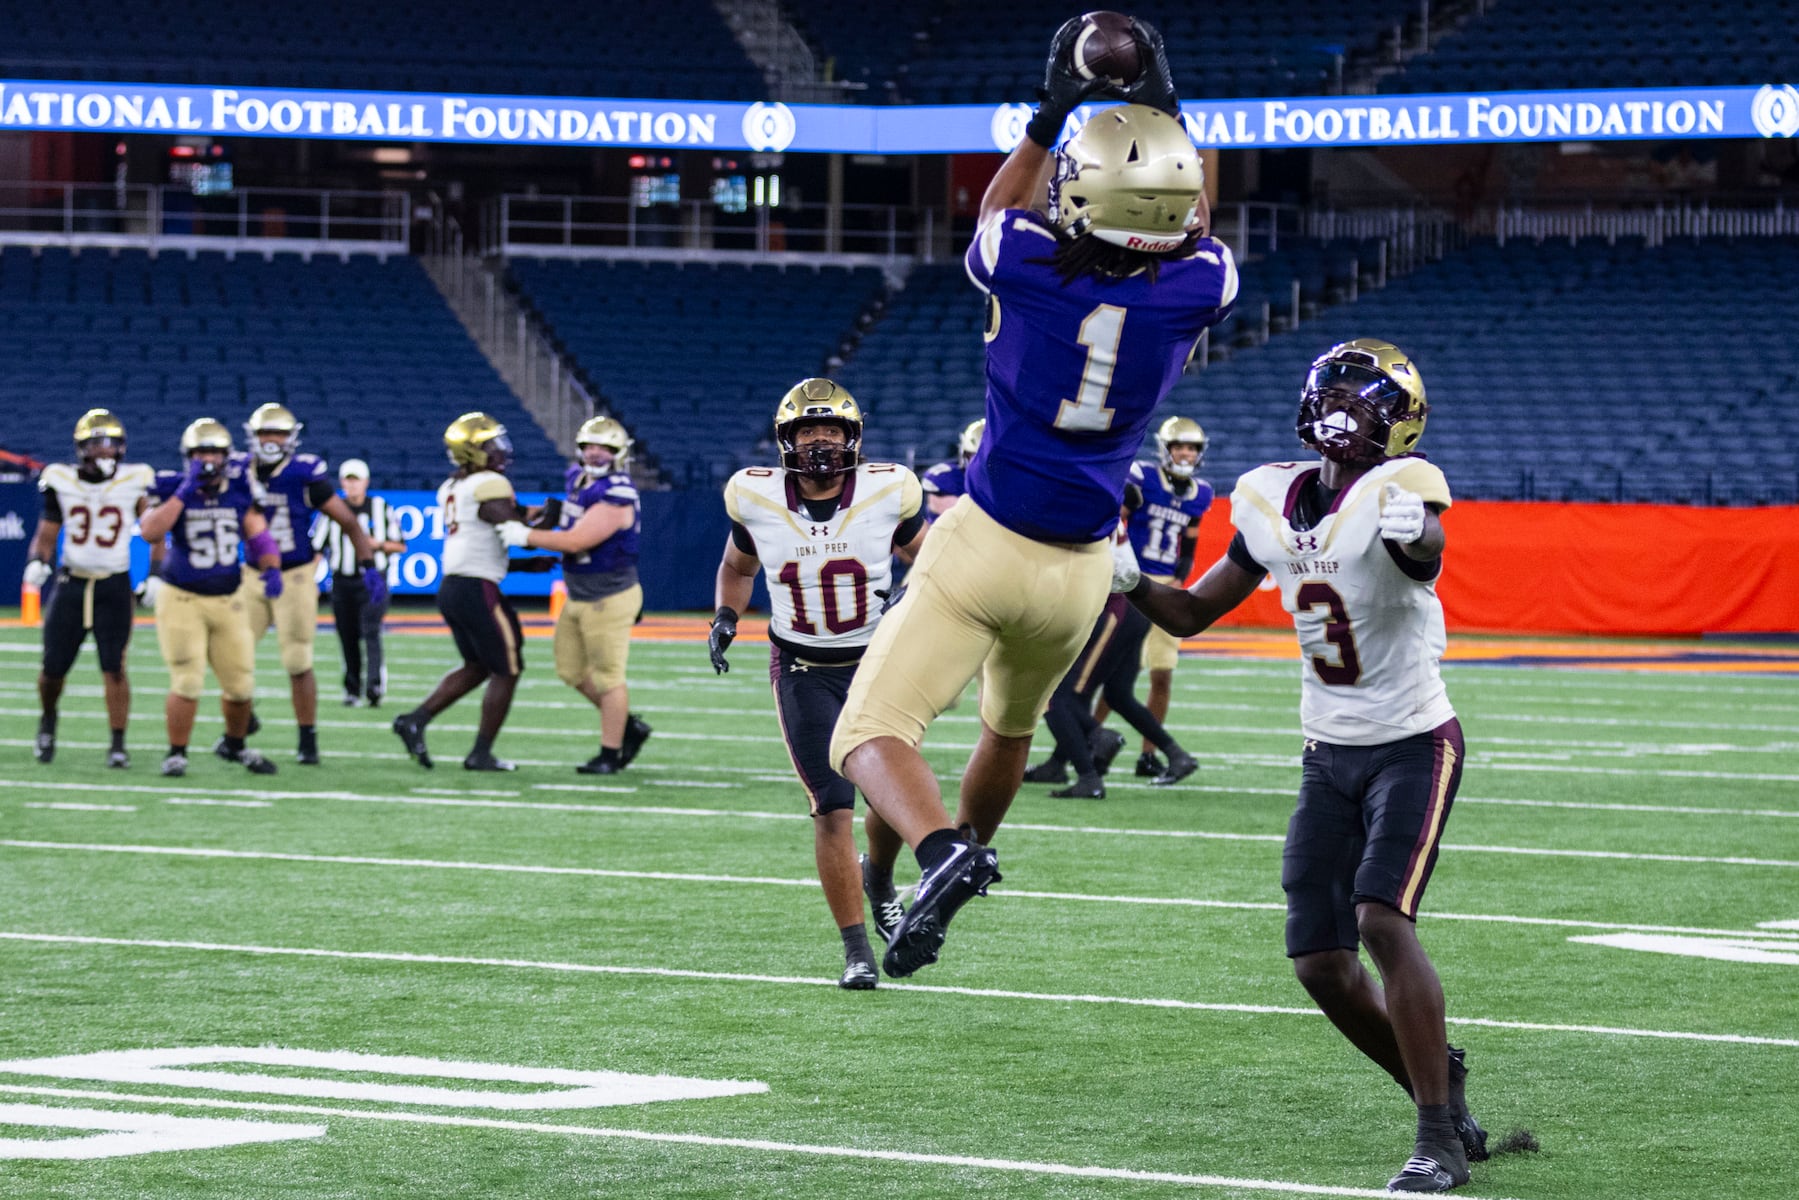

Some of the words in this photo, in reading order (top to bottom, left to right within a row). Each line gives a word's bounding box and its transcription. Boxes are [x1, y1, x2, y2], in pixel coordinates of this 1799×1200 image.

[0, 82, 202, 129] ATIONAL
[211, 89, 433, 137] FOOTBALL
[442, 98, 717, 144] FOUNDATION
[1263, 101, 1459, 143] FOOTBALL
[1467, 97, 1726, 139] FOUNDATION
[1053, 303, 1127, 432] 1
[746, 469, 773, 477] 0
[69, 506, 123, 548] 33
[185, 518, 240, 569] 56
[269, 506, 297, 552] 4
[795, 546, 817, 557] IONA
[825, 543, 848, 553] PREP
[1142, 517, 1182, 564] 11
[1287, 561, 1310, 575] IONA
[1313, 560, 1339, 574] PREP
[779, 557, 868, 636] 10
[1296, 580, 1363, 687] 3
